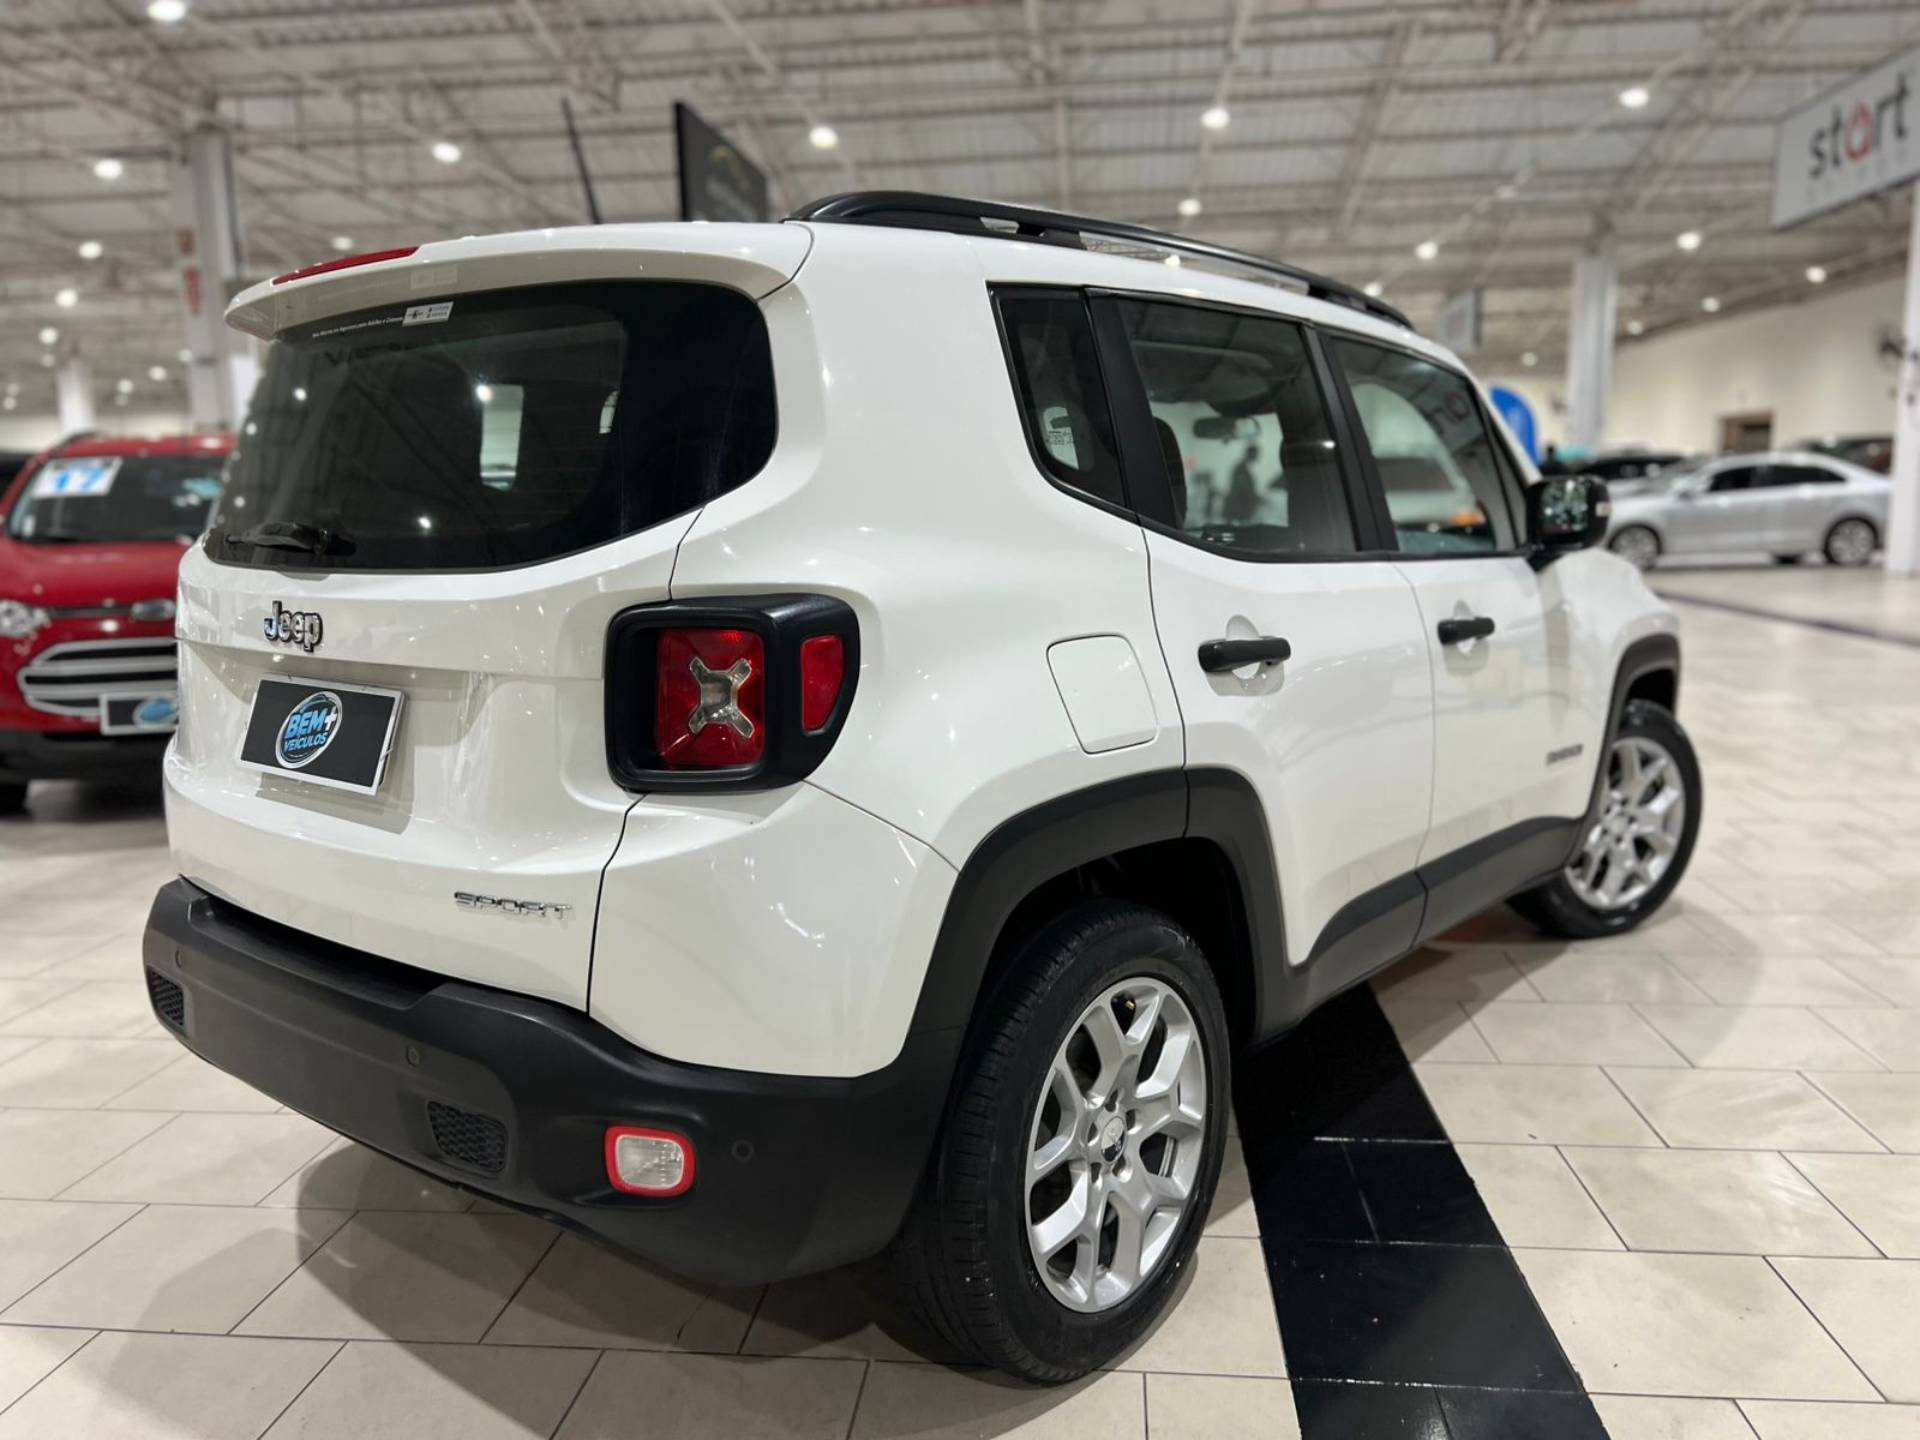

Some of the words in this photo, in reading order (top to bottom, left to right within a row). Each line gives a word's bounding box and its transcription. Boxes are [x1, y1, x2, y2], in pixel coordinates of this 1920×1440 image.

[1809, 74, 1910, 179] start
[264, 600, 323, 652] Jeep
[453, 891, 573, 922] SPORT
